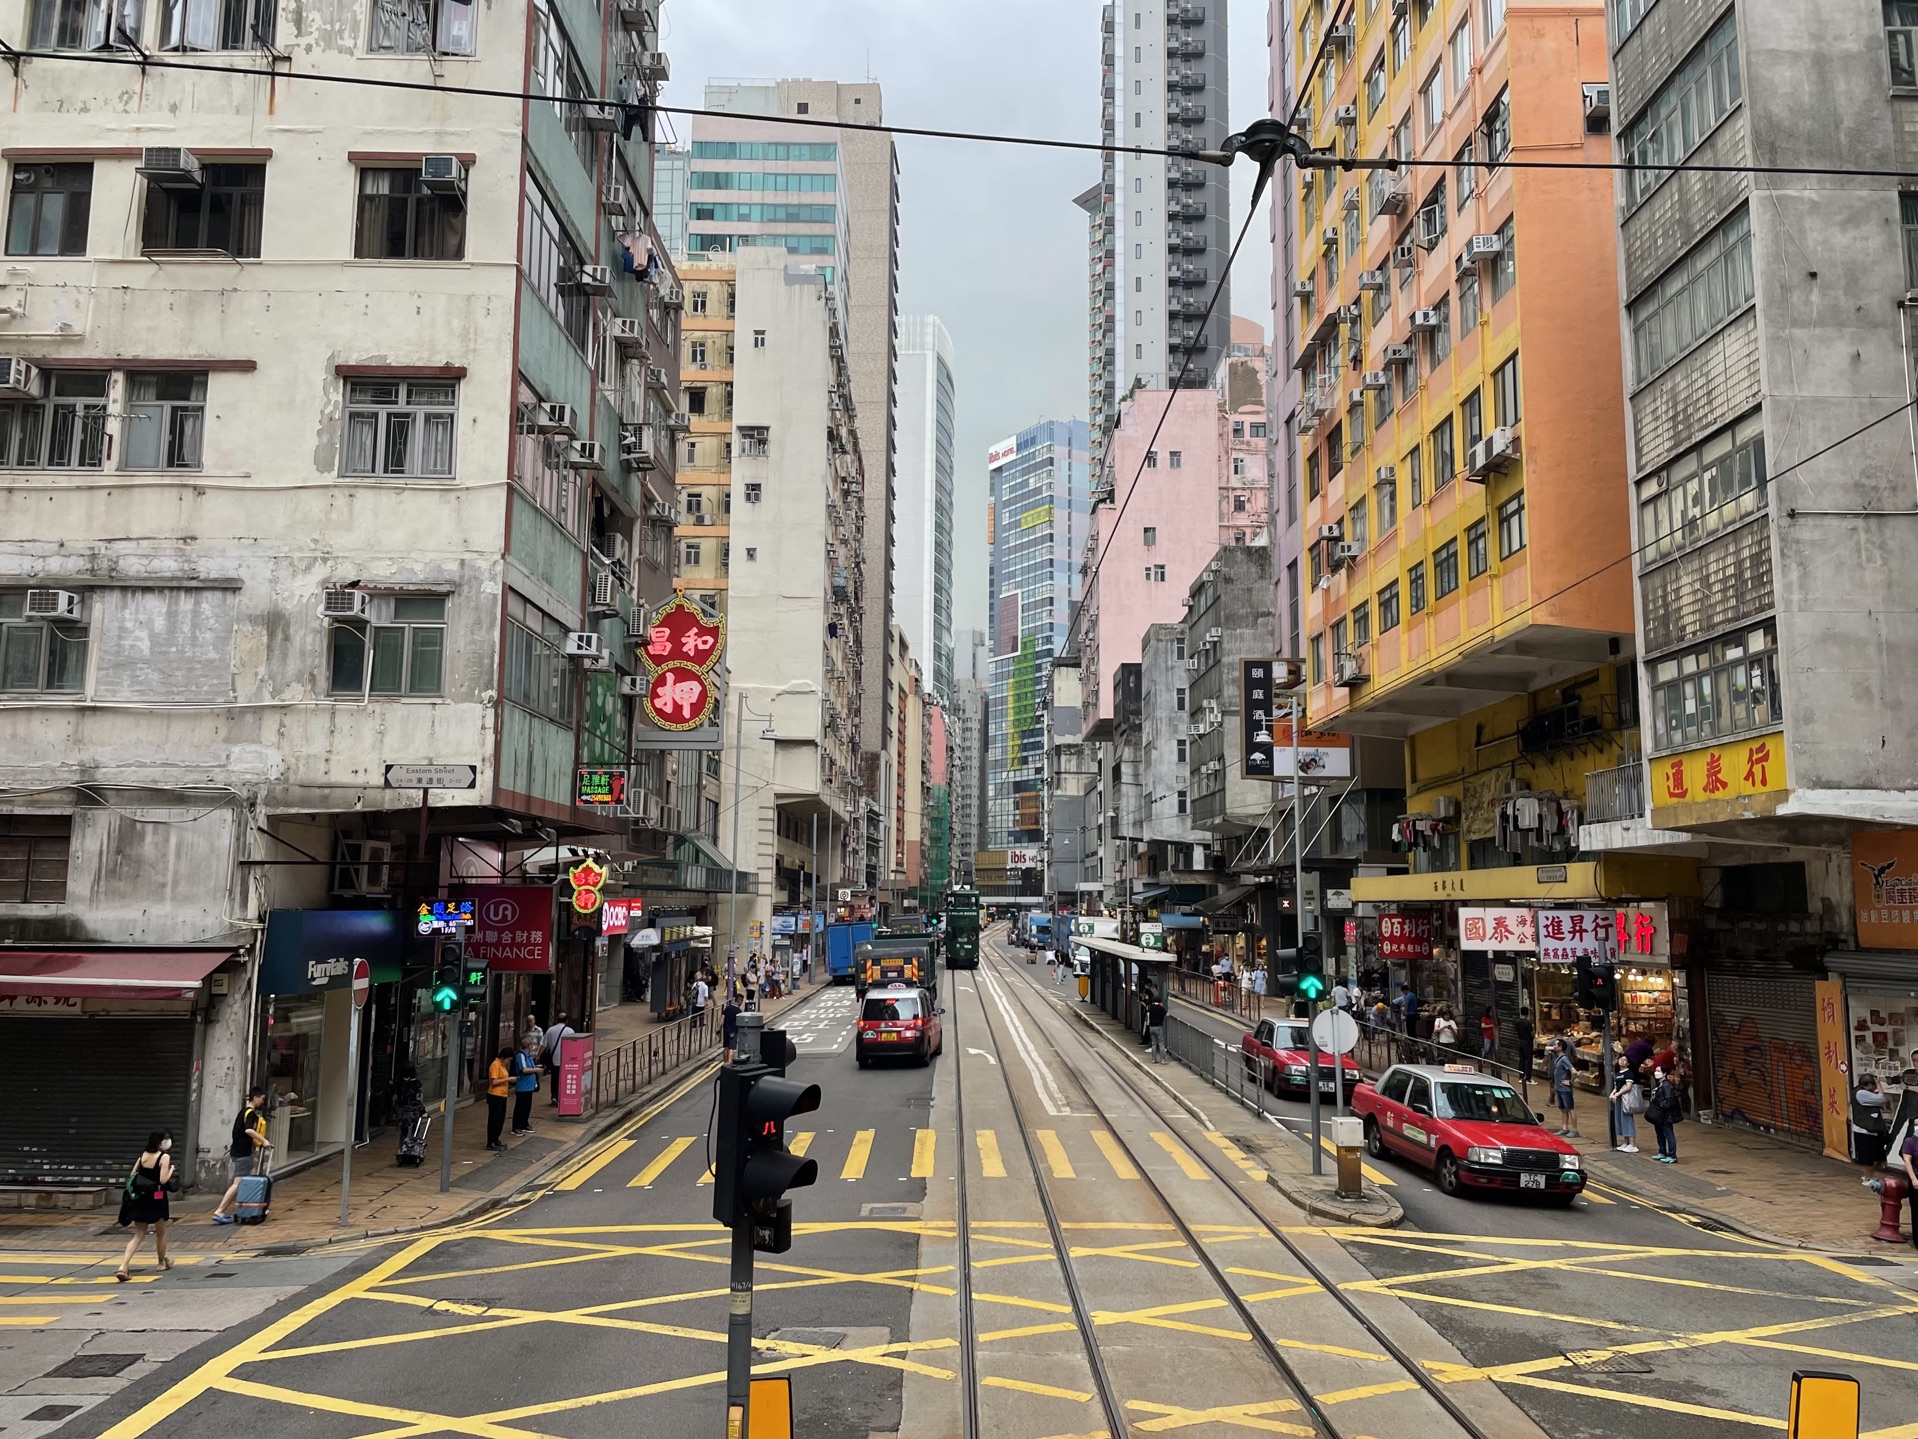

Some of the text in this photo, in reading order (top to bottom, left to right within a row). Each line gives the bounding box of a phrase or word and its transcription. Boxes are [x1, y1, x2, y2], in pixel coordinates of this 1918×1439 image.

[988, 447, 1015, 464] ibis HOTEL
[647, 627, 714, 657] 昌和
[654, 672, 702, 719] 押
[1665, 742, 1770, 799] 通泰行
[581, 786, 610, 794] MASSAGE
[1010, 851, 1026, 864] ibis
[573, 872, 600, 885] 昌和
[575, 891, 596, 908] 押
[1391, 918, 1431, 939] 百利行
[1464, 915, 1515, 944] 國泰
[1543, 914, 1615, 943] 進昇行
[480, 946, 542, 959] FINANCE
[1581, 947, 1617, 960] 海味貨
[778, 1020, 837, 1030] 巴士
